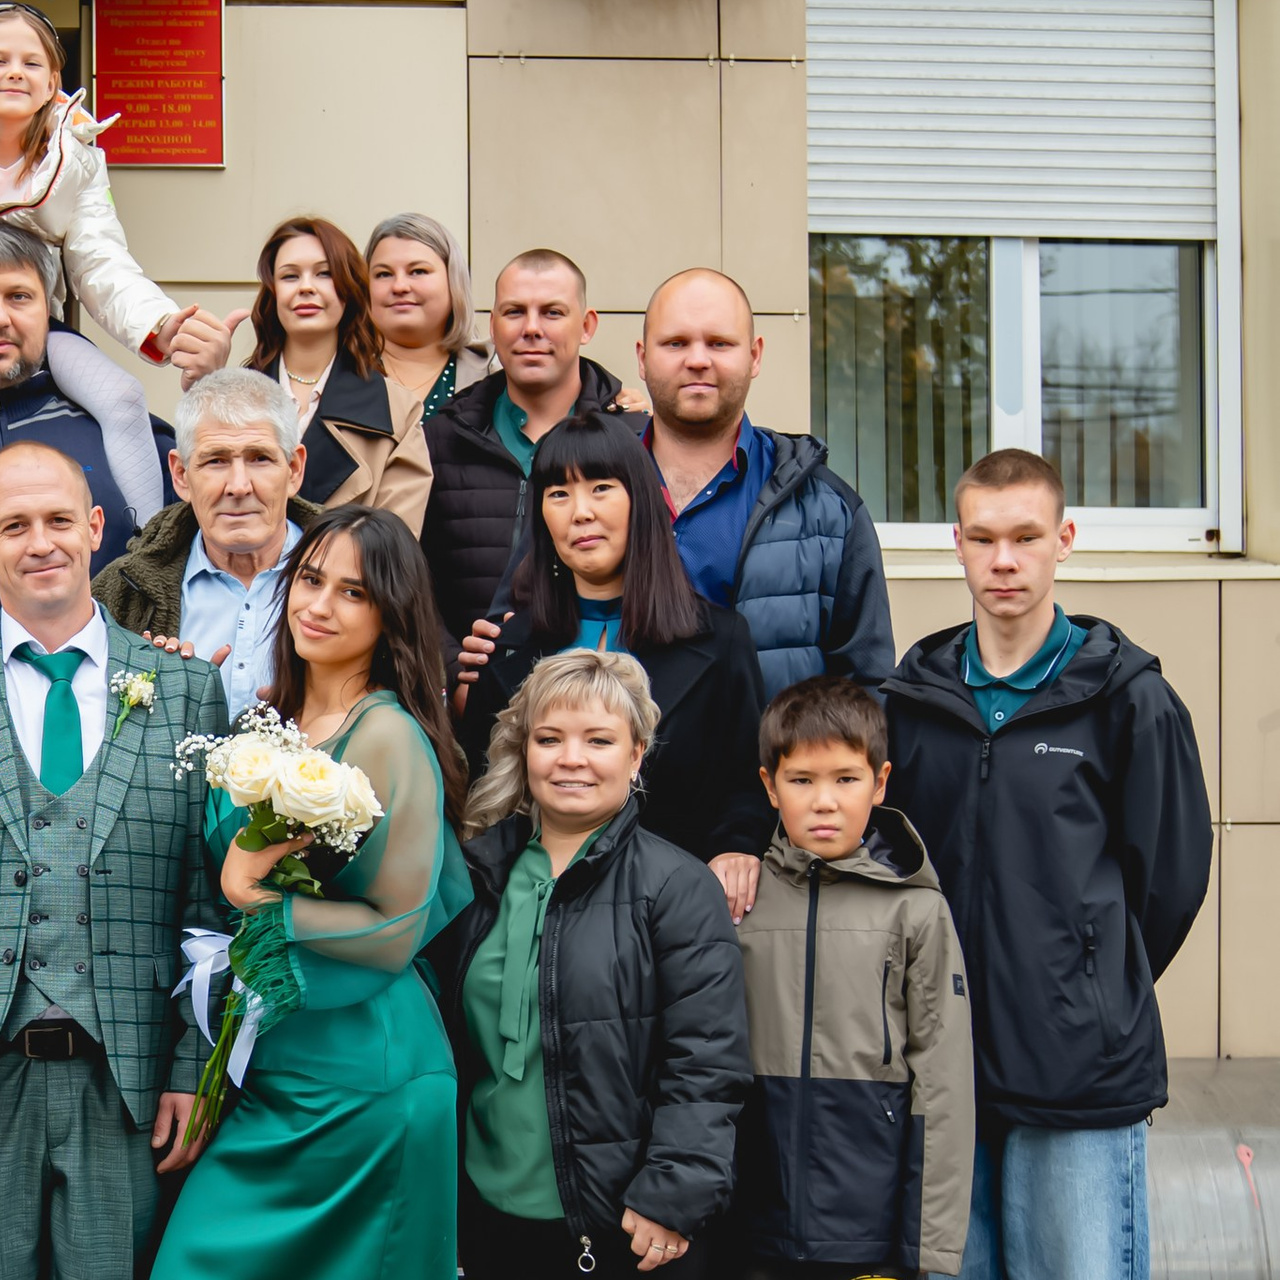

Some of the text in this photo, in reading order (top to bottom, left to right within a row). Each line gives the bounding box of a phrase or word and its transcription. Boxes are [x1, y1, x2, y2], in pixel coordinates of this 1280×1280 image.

[111, 79, 155, 89] РЕЖИМ
[125, 103, 151, 114] 9.00
[161, 103, 192, 114] 18.00
